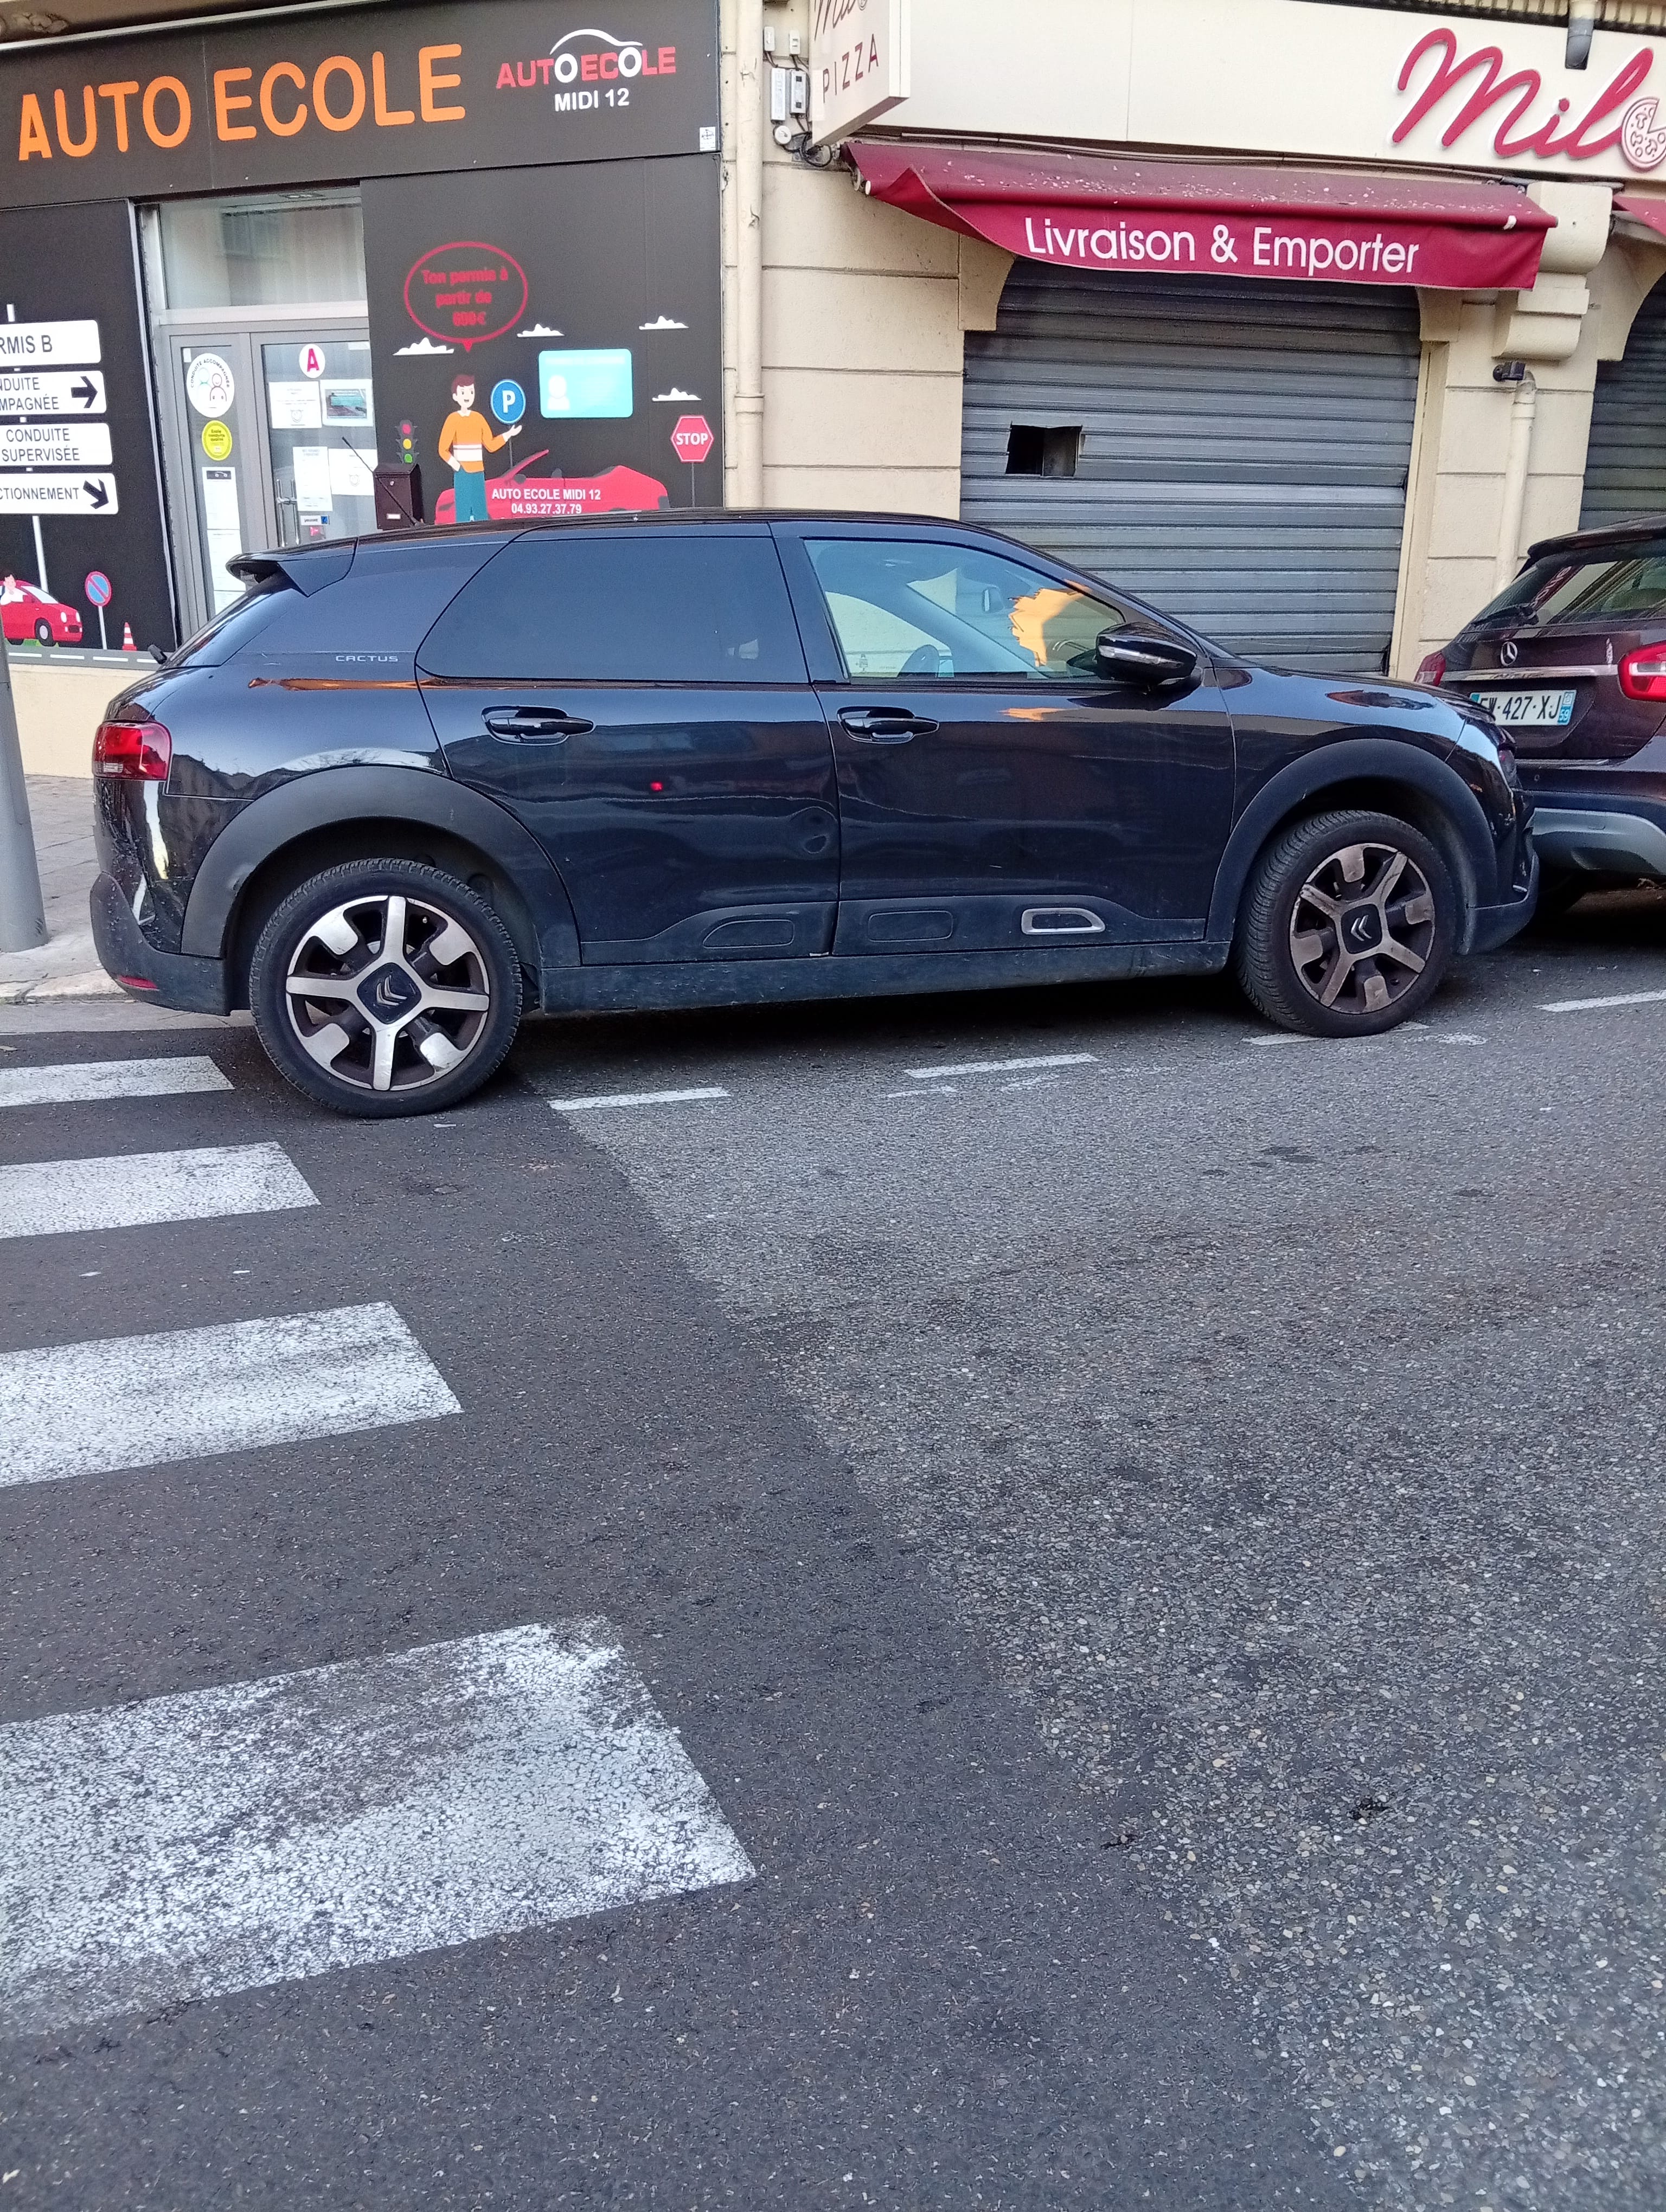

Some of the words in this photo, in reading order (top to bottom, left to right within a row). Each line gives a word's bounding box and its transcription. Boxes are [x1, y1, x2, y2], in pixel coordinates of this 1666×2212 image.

[823, 34, 879, 104] PIZZA
[18, 75, 191, 161] AUTO
[213, 43, 466, 142] ECOLE
[554, 89, 598, 112] MIDI
[605, 87, 630, 107] 12
[1025, 217, 1195, 261] Livraison
[1210, 224, 1238, 263] &
[1253, 227, 1419, 275] Emporter
[41, 335, 53, 352] B
[307, 348, 320, 372] A
[502, 390, 515, 413] P
[6, 428, 71, 442] CONDUITE
[676, 432, 708, 446] STOP
[2, 444, 80, 462] SUPERVISÉE
[492, 488, 521, 499] AUTO
[524, 489, 560, 500] ECOLE
[563, 489, 586, 500] MIDI
[589, 490, 601, 500] 12
[511, 503, 582, 515] 04.93.27.37.79
